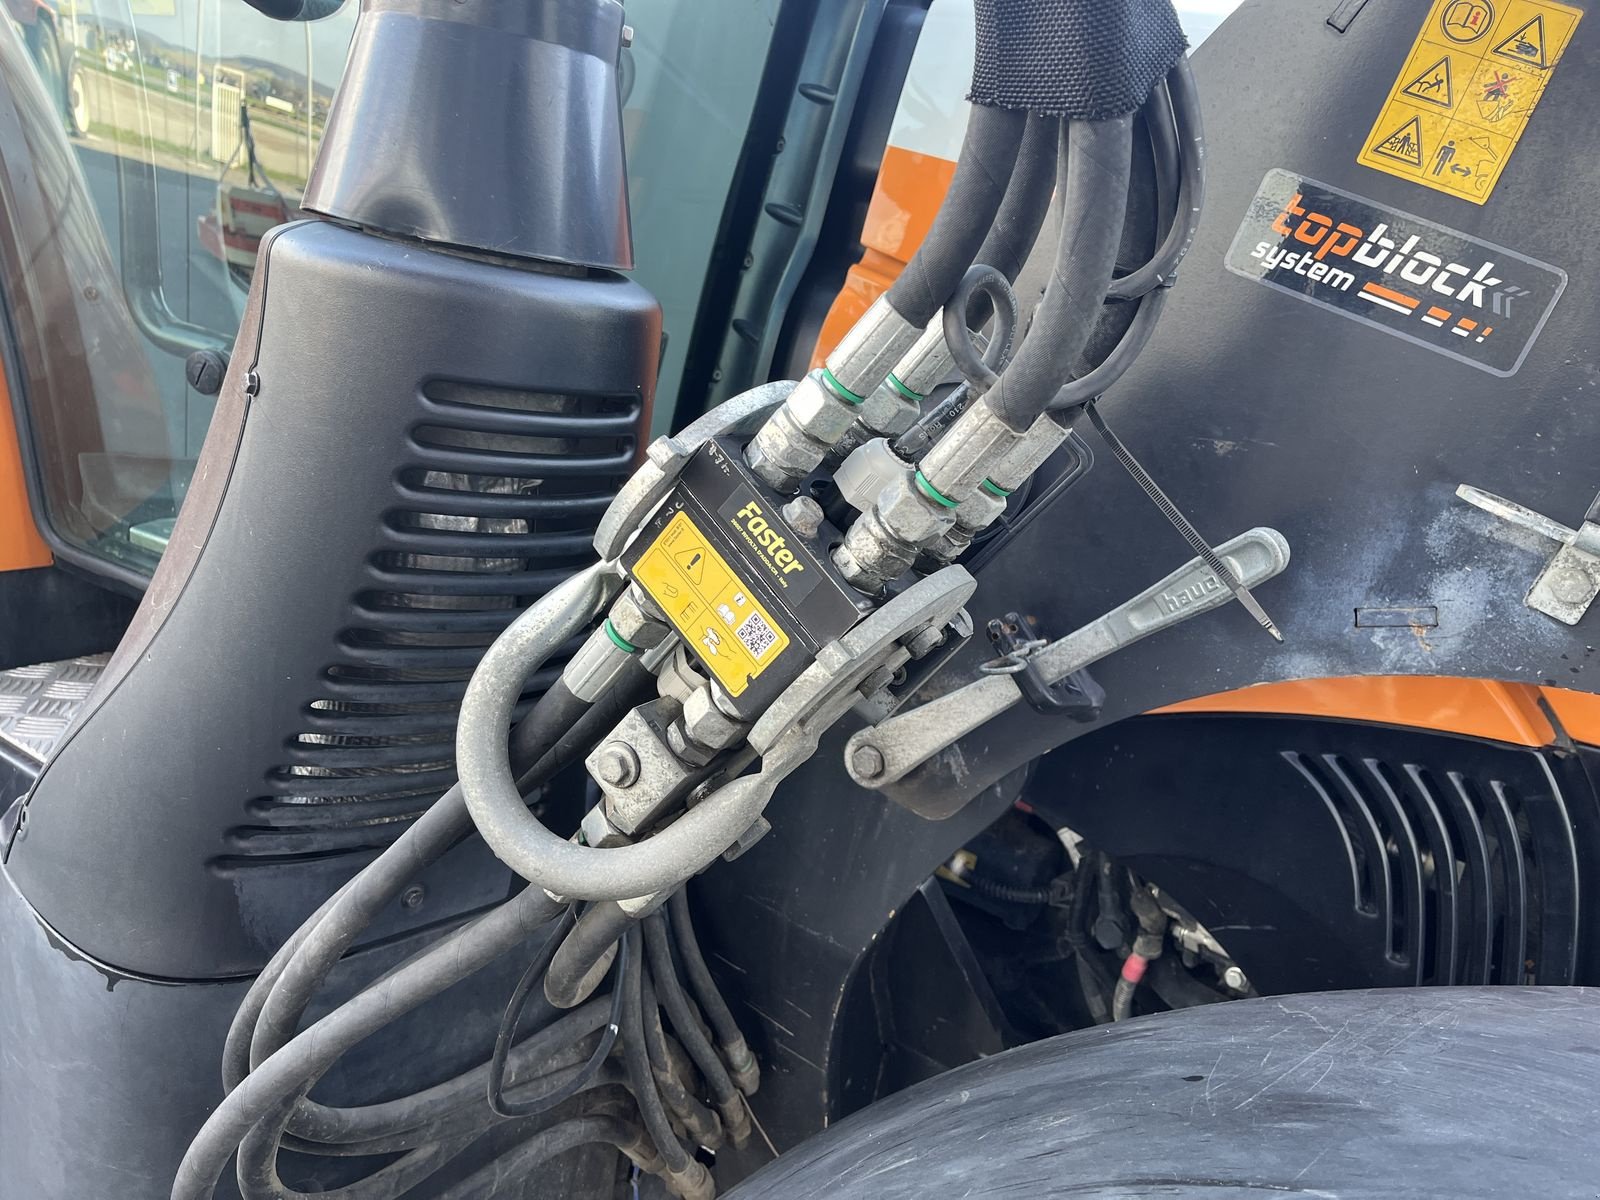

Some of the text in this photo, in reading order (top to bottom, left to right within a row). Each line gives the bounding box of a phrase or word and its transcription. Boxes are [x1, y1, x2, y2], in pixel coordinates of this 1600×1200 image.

[1251, 240, 1355, 292] system
[949, 403, 965, 417] 210
[736, 500, 804, 575] Faster
[741, 530, 758, 552] RIVOLTA
[1163, 574, 1225, 612] haue
